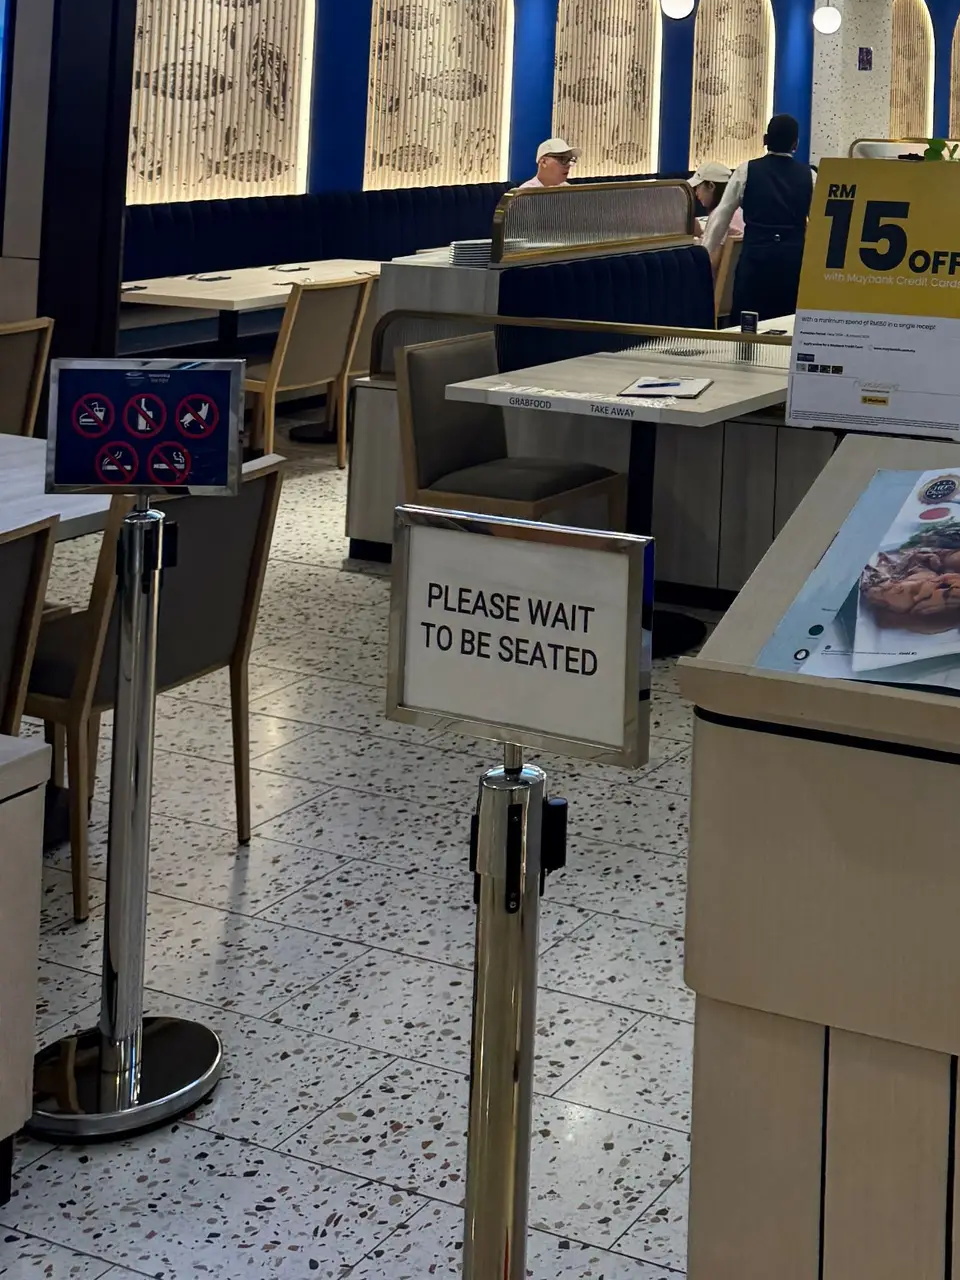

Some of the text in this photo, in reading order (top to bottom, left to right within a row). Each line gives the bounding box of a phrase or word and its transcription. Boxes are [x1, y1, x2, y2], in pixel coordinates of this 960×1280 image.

[828, 183, 857, 199] RM
[825, 198, 910, 271] 15
[824, 271, 845, 283] with
[846, 273, 894, 286] Maybank
[896, 275, 928, 288] Credit
[509, 396, 552, 409] GRABFOOD
[590, 404, 635, 418] TAKE AWAY
[427, 582, 595, 633] PLEASE WAIT
[420, 621, 598, 676] TO BE SEATED
